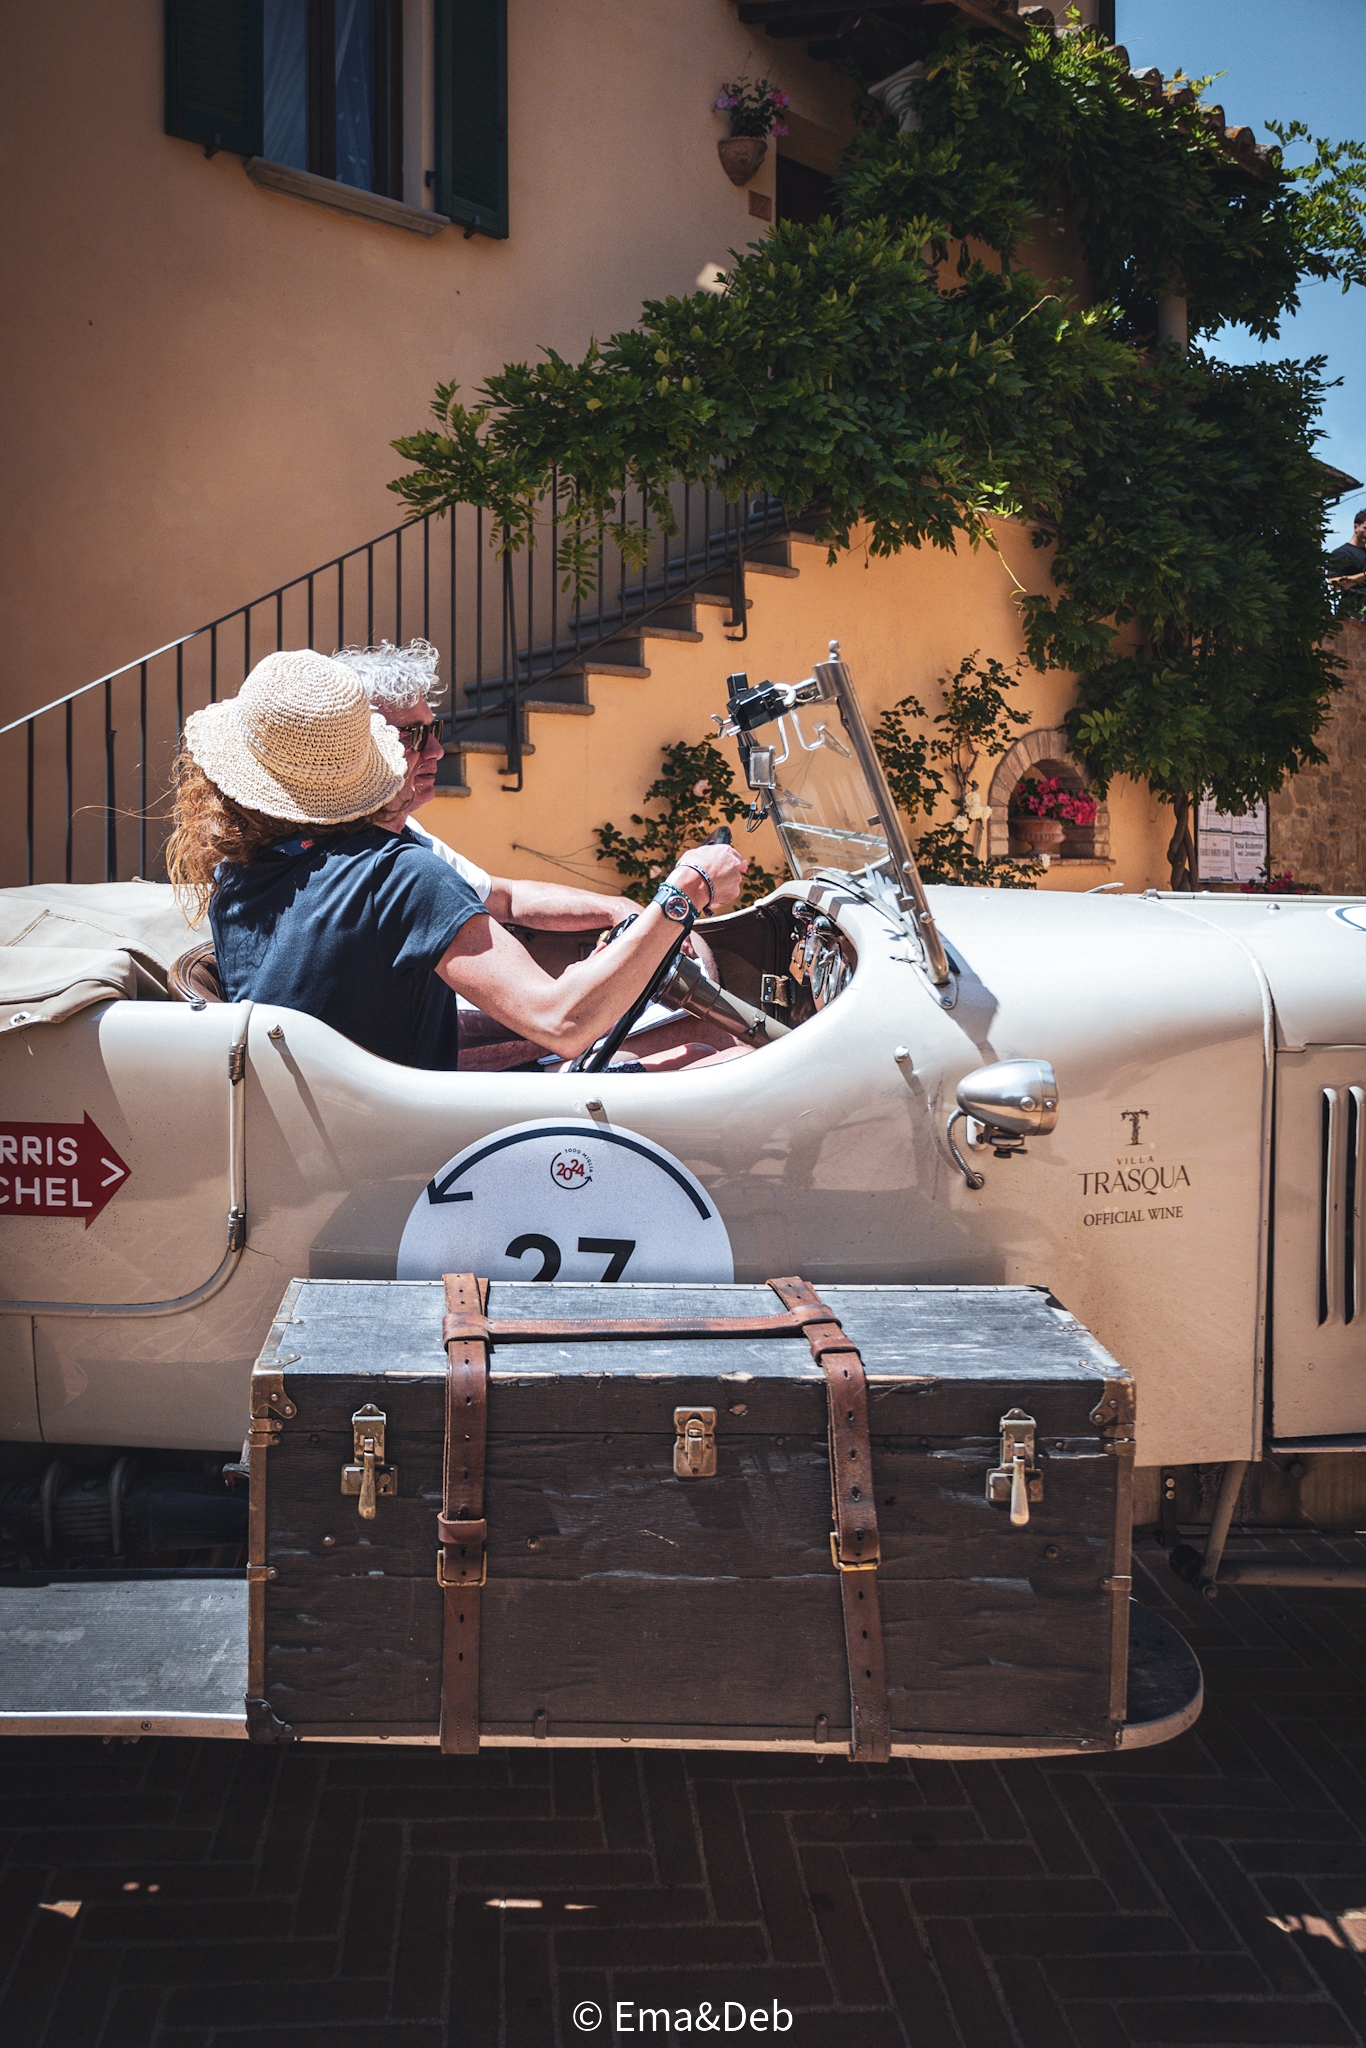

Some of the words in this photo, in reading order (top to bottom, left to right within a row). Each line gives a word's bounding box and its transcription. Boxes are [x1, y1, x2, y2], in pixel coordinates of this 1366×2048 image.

[556, 1159, 585, 1181] 2024
[582, 1152, 593, 1173] MIGLIA
[1117, 1156, 1154, 1165] VILLA
[1078, 1165, 1191, 1195] TRASQUA
[1083, 1210, 1145, 1227] OFFICIAL
[1147, 1206, 1184, 1220] WINE
[505, 1233, 636, 1283] 27
